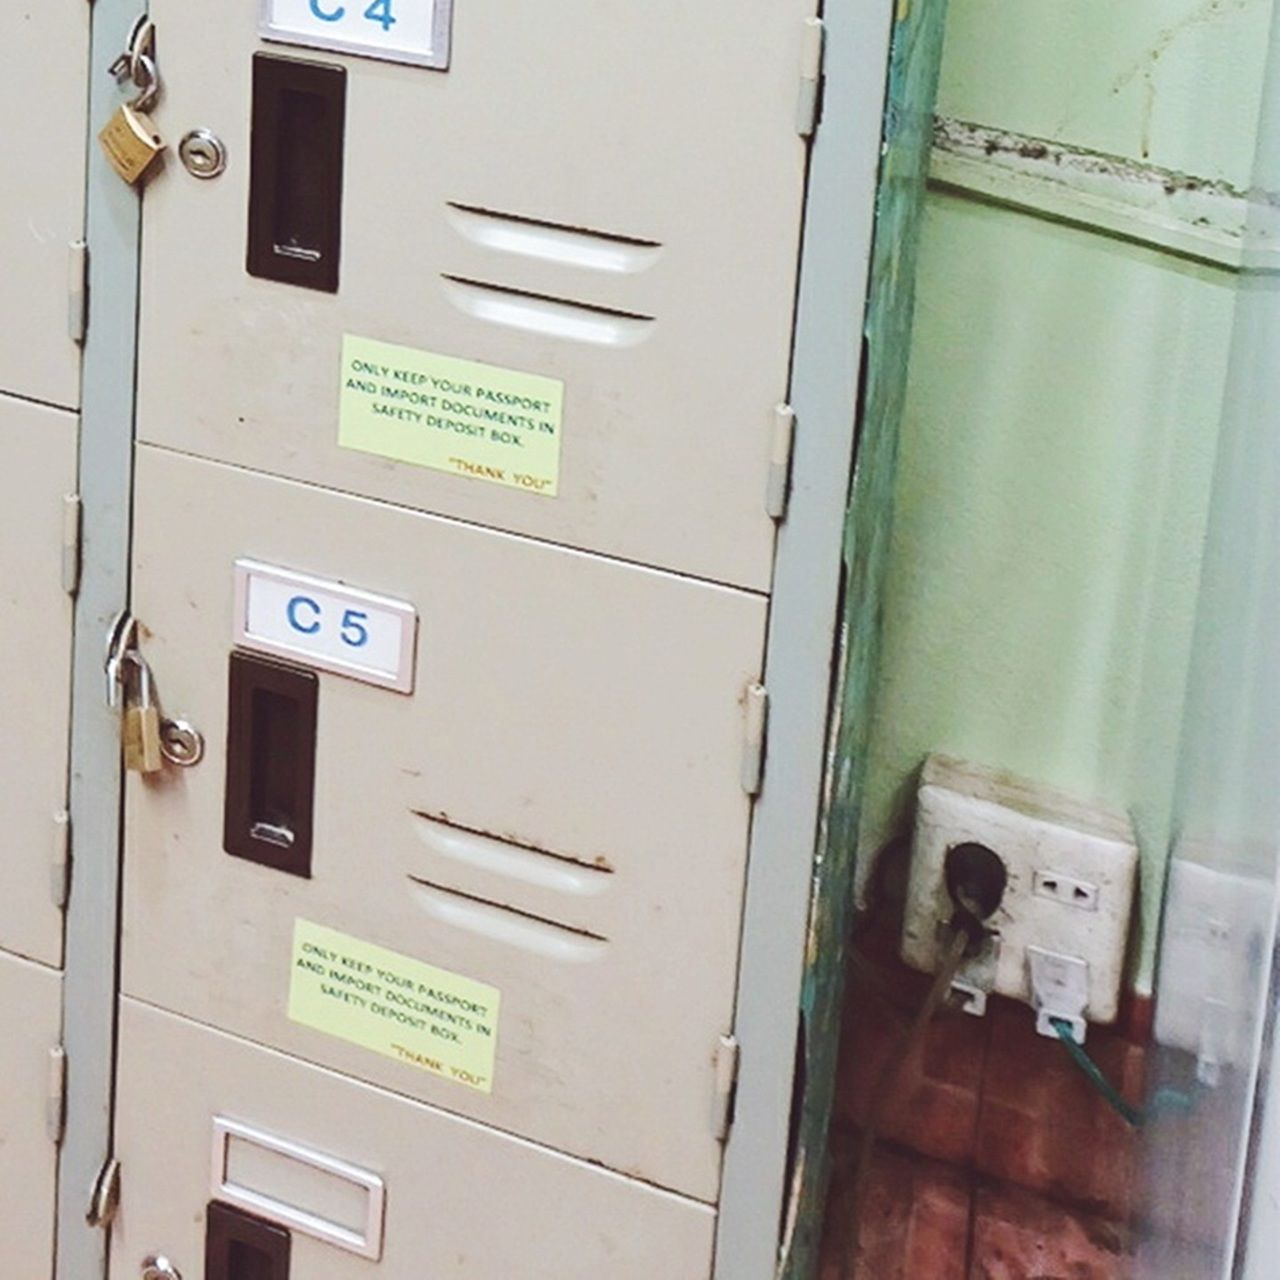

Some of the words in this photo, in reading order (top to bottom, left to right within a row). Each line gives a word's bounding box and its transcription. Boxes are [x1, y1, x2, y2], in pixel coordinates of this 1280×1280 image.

[346, 377, 376, 394] AND
[381, 384, 436, 408] IMPORT
[441, 398, 534, 430] DOCUMENTS
[539, 420, 554, 434] IN
[351, 358, 389, 378] ONLY
[393, 368, 427, 386] KEEP
[430, 376, 471, 396] YOUR
[475, 386, 550, 414] PASSPORT
[371, 401, 421, 424] SAFETY
[426, 414, 485, 438] DEPOSIT
[490, 428, 523, 447] BOX.
